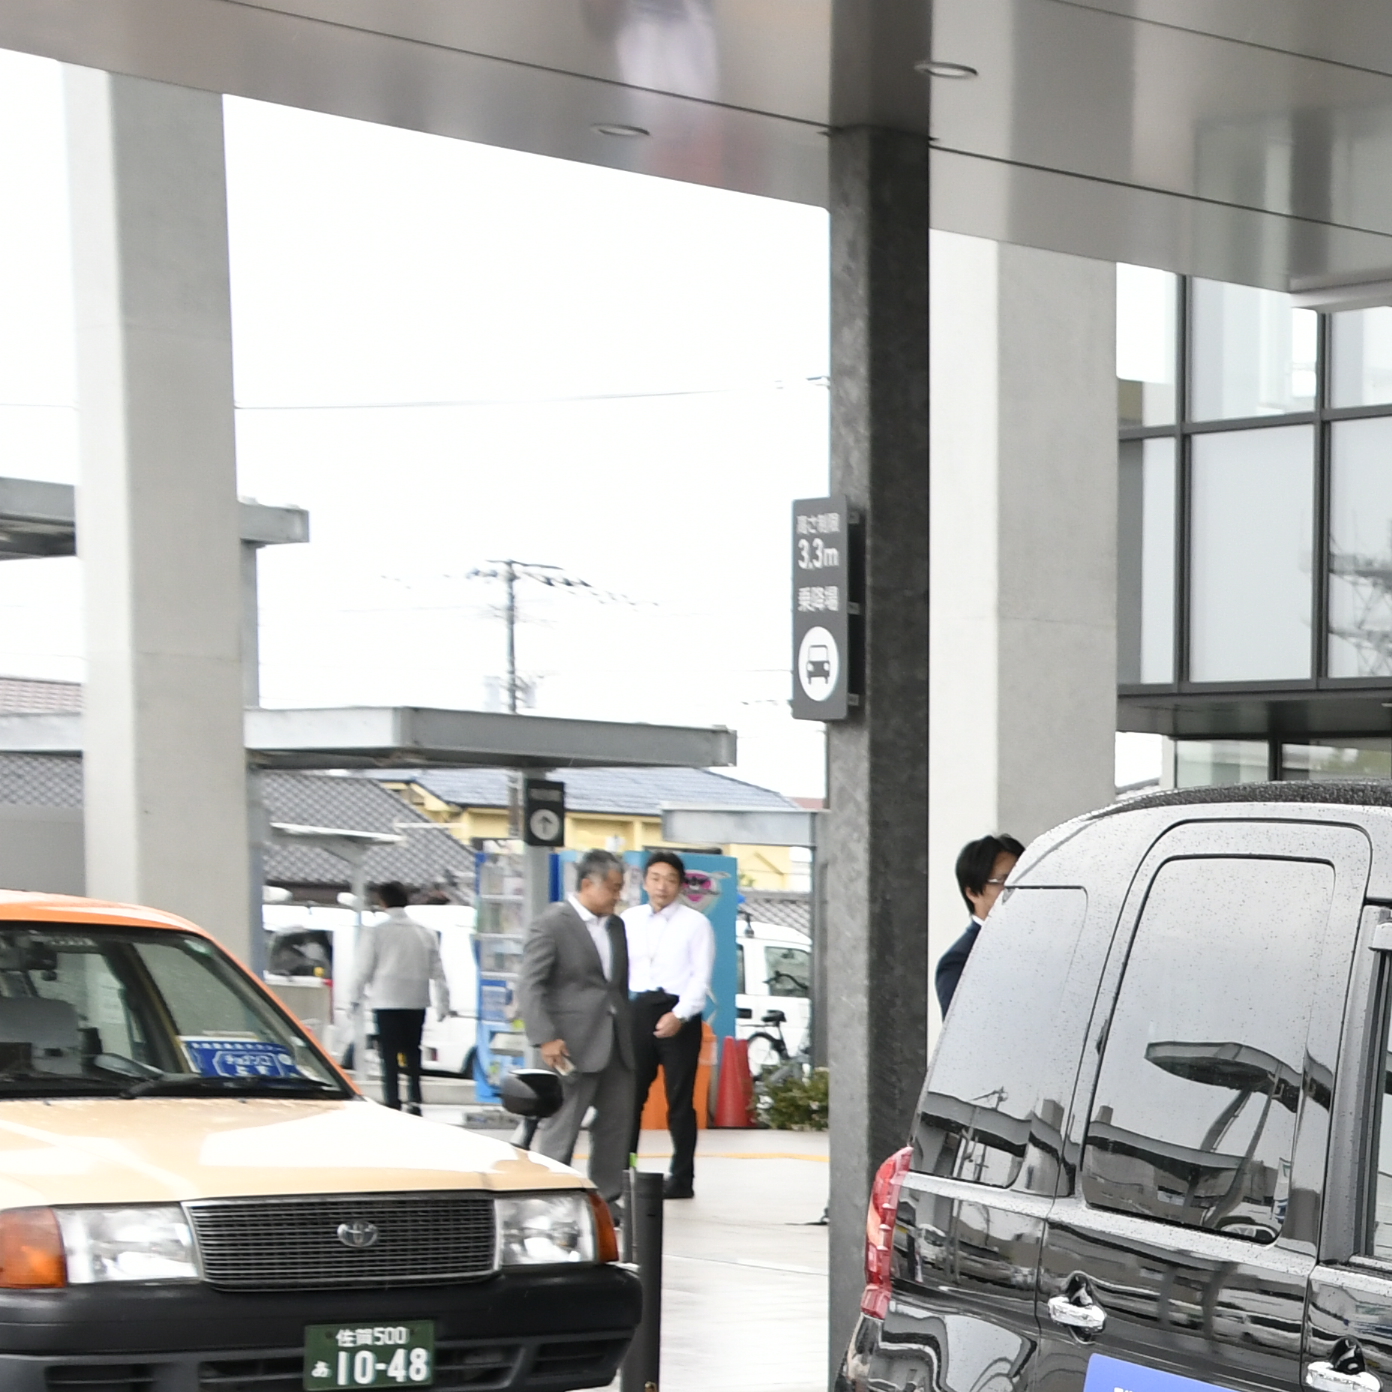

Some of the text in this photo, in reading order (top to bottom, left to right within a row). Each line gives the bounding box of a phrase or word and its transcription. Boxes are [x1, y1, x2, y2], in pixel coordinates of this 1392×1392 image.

[798, 538, 840, 570] 3.3m
[798, 586, 839, 612] 乗降場
[335, 1326, 410, 1348] 佐賀500
[337, 1347, 429, 1386] 10-48
